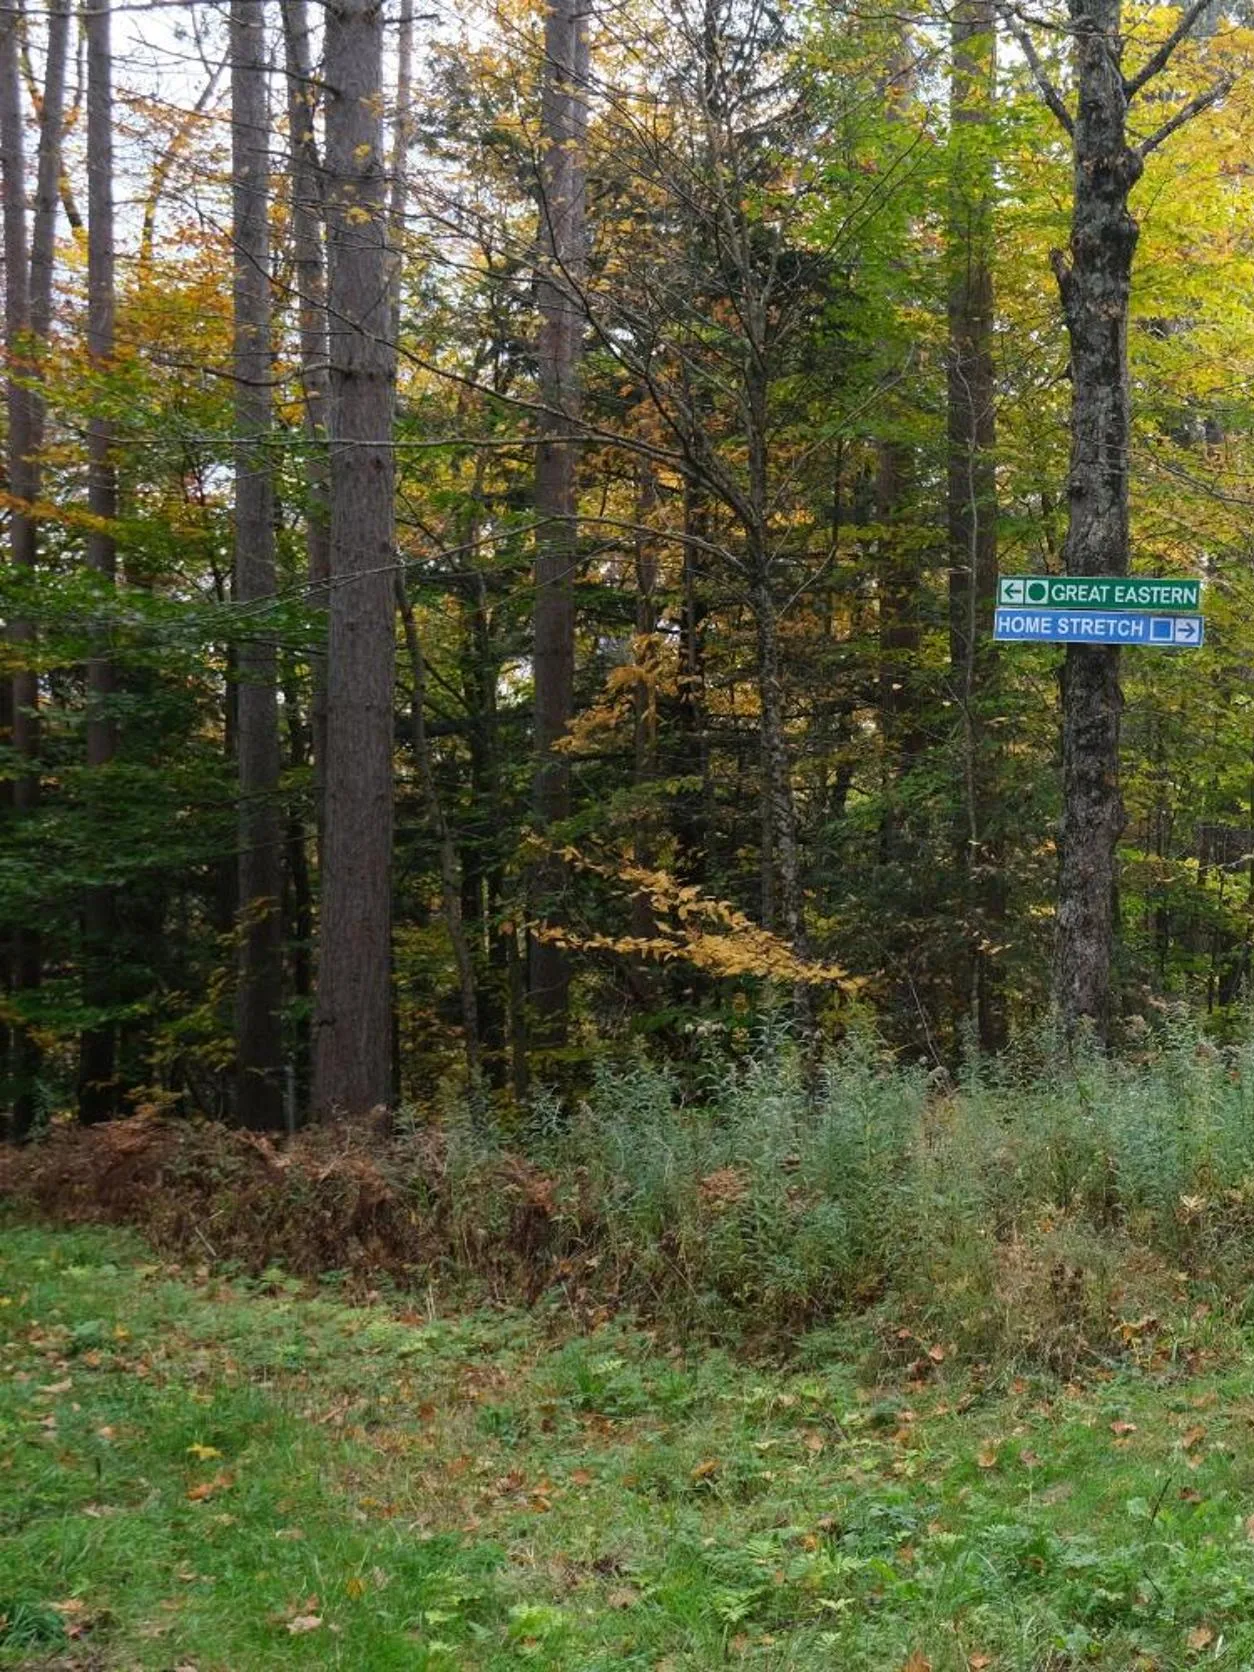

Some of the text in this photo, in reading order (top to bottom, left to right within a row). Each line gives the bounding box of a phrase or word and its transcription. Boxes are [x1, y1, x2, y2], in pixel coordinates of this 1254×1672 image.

[1051, 584, 1197, 604] GREAT EASTERN
[999, 616, 1144, 636] HOME STRETCH
